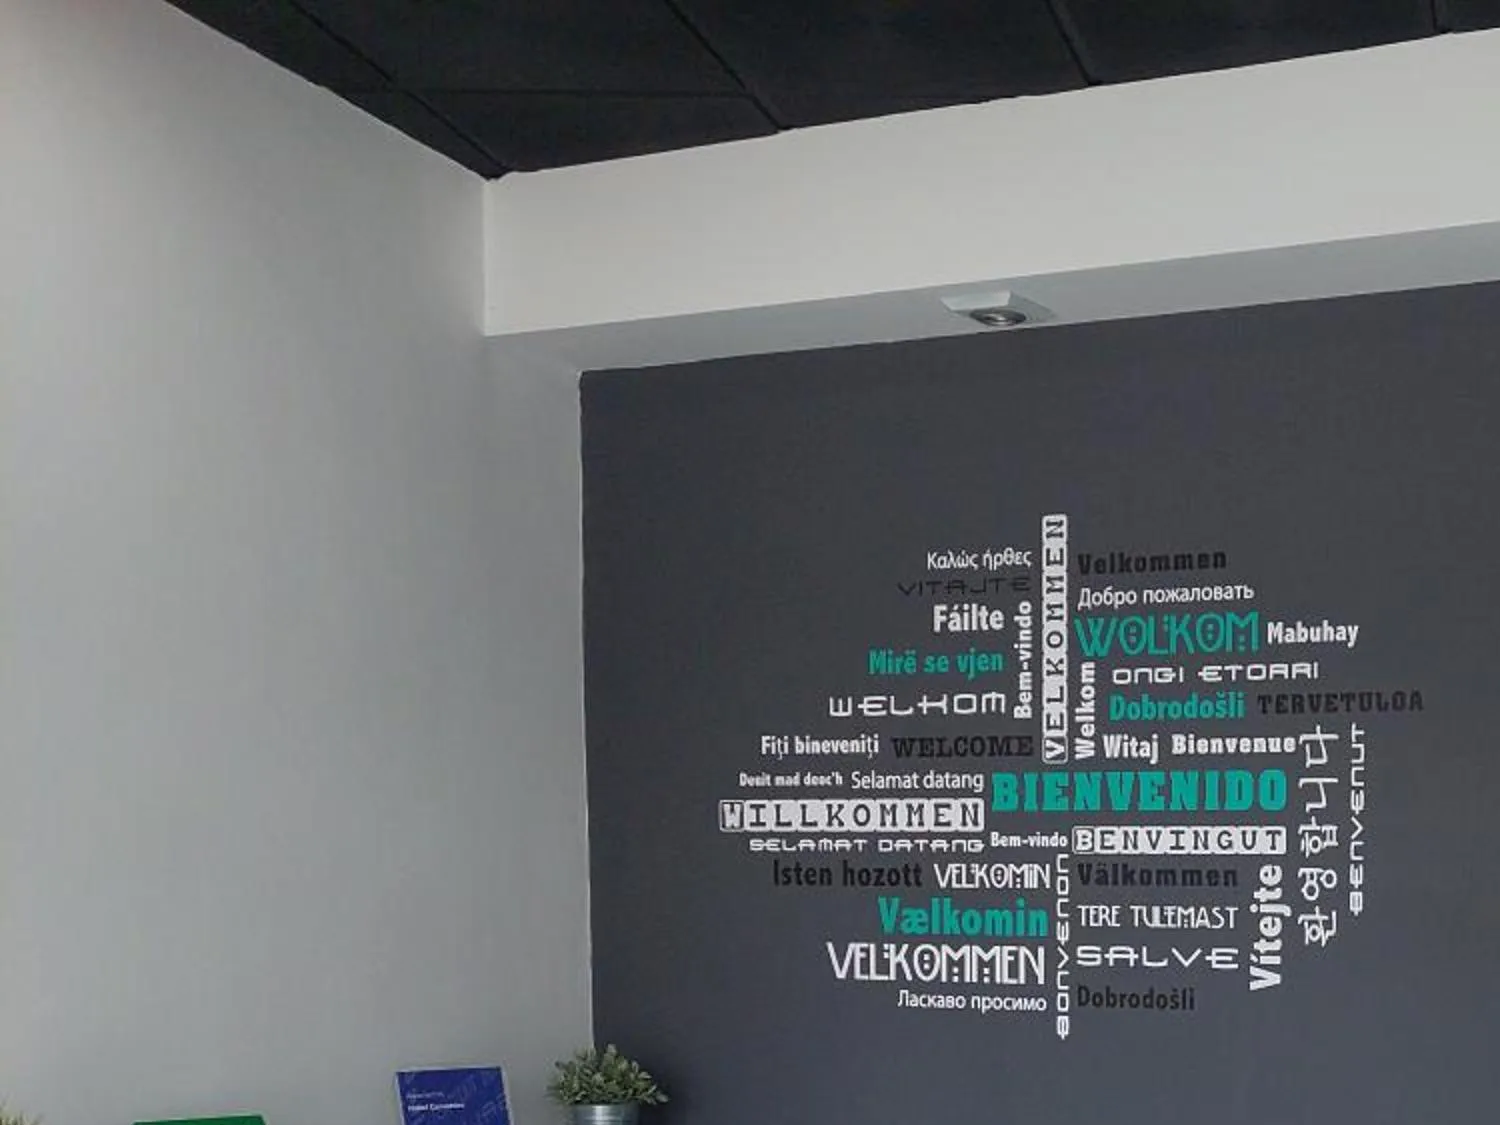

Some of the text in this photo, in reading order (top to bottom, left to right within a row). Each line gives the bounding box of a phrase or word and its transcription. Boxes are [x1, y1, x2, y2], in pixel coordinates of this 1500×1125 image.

[927, 548, 1031, 570] Καλώς ήρθες
[1077, 551, 1227, 575] Velkommen
[898, 577, 1031, 596] VITAJTE
[1077, 584, 1254, 611] Добро пожаловать
[933, 604, 1005, 632] Fáilte
[1042, 514, 1067, 763] VELKOMMEN
[1267, 620, 1358, 647] Mabuhay
[868, 648, 1003, 681] Mirë se vjen
[1013, 601, 1032, 718] Bem-vindo
[1075, 662, 1096, 760] Welkom
[1109, 692, 1245, 720] Dobrodošli
[891, 736, 1033, 758] WELCOME
[1103, 734, 1159, 764] Witaj
[1171, 733, 1296, 754] Bienvenue
[851, 770, 984, 793] Selamat datang
[991, 770, 1288, 812] BIENVENIDO
[719, 798, 985, 833] WILLKOMMEN
[990, 831, 1068, 848] Bem-vindo
[1072, 826, 1287, 854] BENVINGUT
[1298, 725, 1339, 947] 환영합니다
[773, 860, 923, 887] Isten hozott
[1077, 862, 1238, 887] Välkommen
[877, 897, 1049, 937] Vælkomin
[1077, 905, 1120, 927] TERE
[825, 942, 1046, 985] VELKOMMEN
[1076, 946, 1239, 969] SALVE
[897, 989, 1047, 1014] Ласкаво просимо
